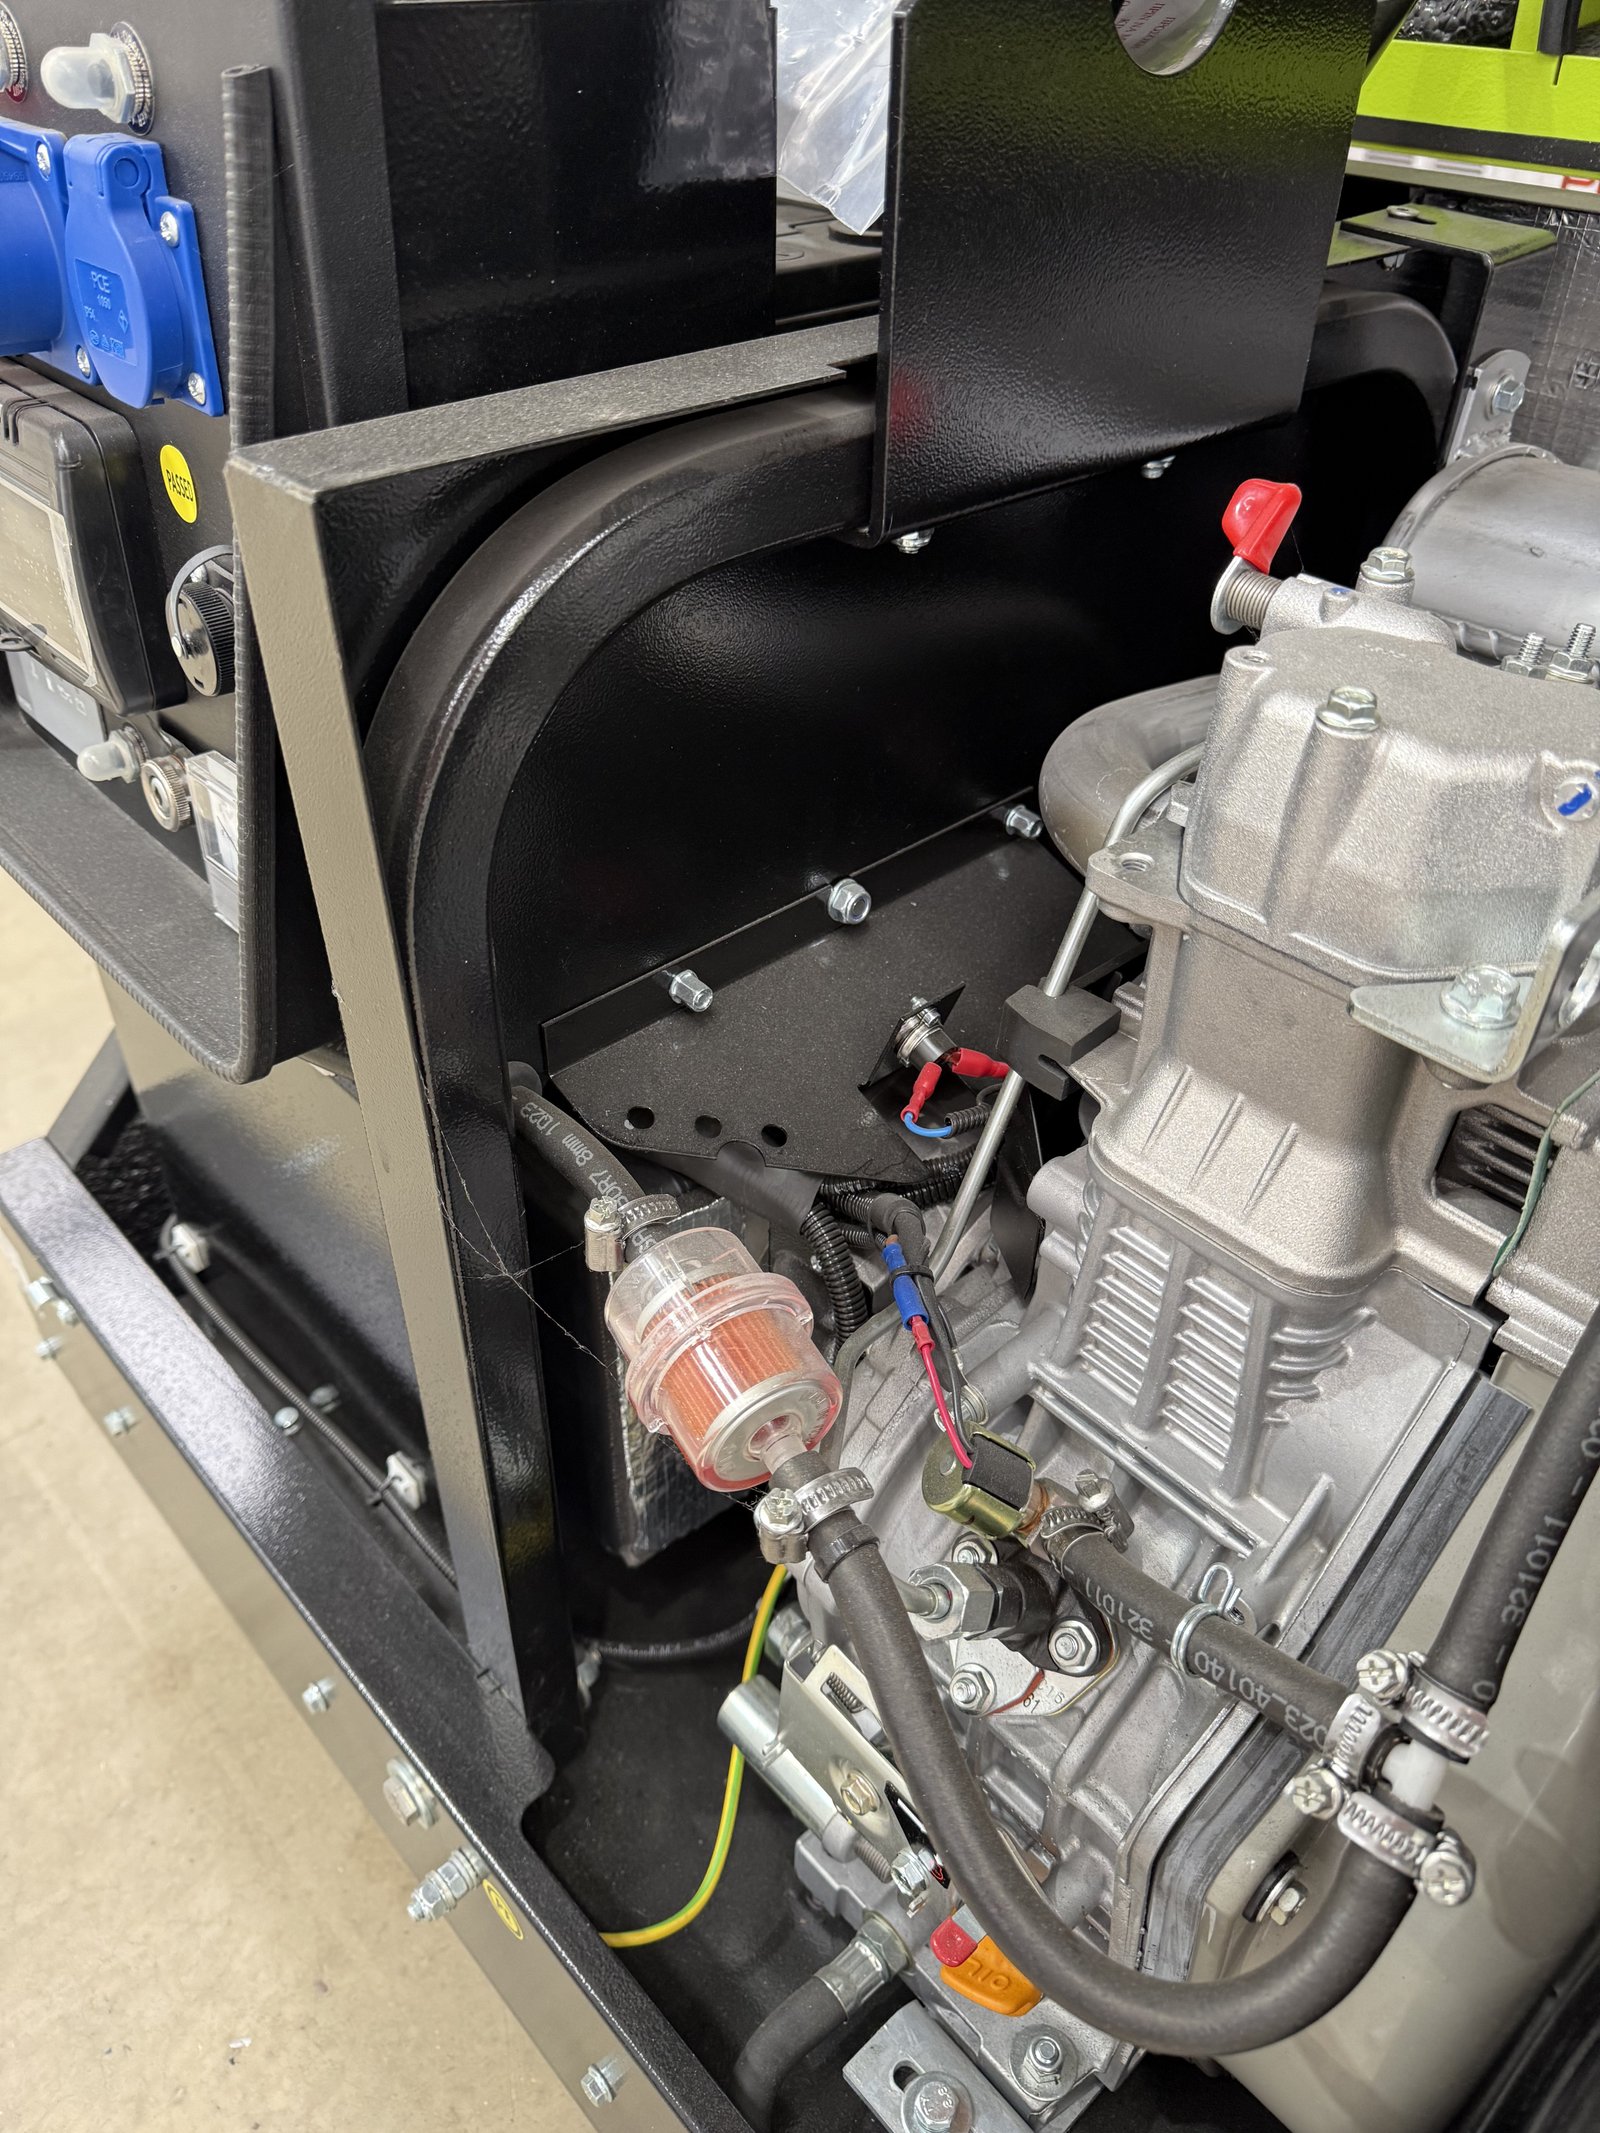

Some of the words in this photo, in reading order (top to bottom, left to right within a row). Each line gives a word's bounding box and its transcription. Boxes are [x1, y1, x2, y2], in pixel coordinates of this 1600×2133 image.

[90, 270, 111, 294] PCE
[165, 468, 194, 502] PASSED
[561, 1133, 594, 1168] 8mm
[1501, 1513, 1568, 1627] 321011
[1085, 1576, 1154, 1642] 321011
[969, 1955, 1012, 1991] OIL
